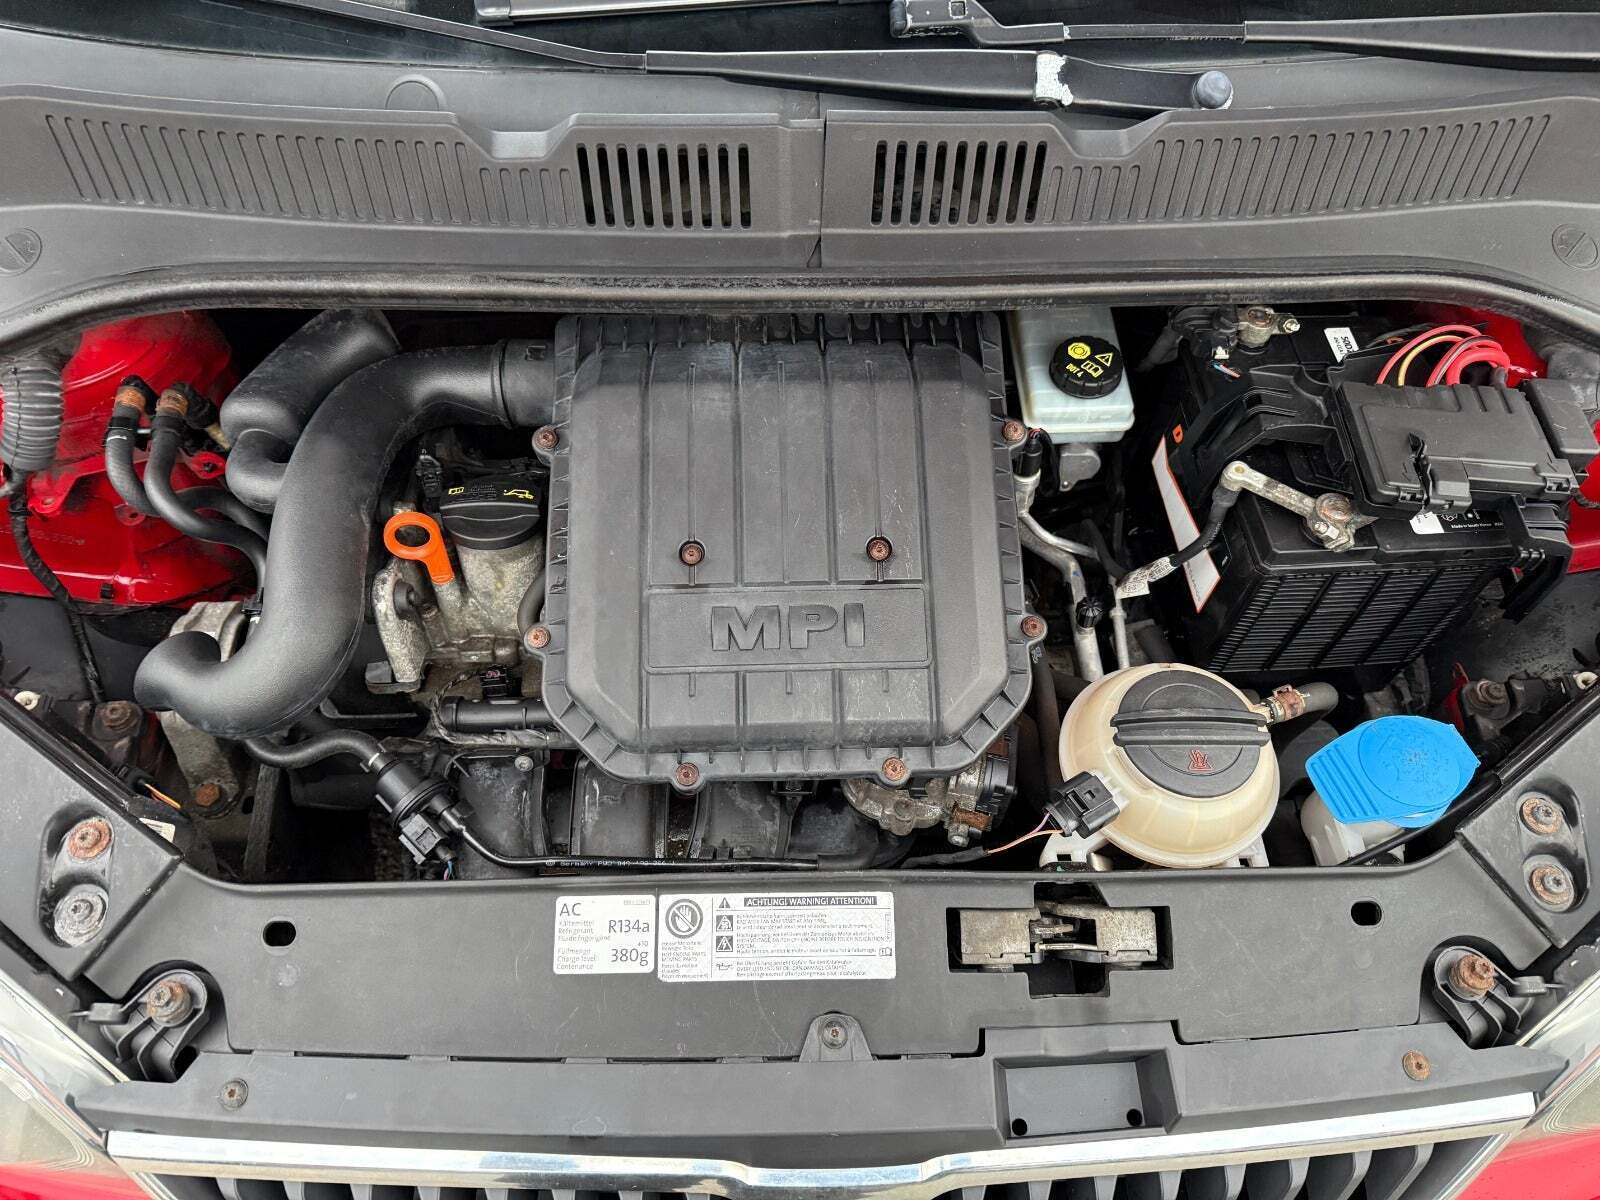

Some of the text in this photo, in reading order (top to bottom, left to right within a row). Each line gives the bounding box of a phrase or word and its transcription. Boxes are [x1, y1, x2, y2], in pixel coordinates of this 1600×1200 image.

[1066, 363, 1079, 374] DOT
[711, 602, 866, 651] MPI
[746, 896, 875, 906] ACHTUNG! WARNING! ATTENTION!
[559, 902, 582, 917] AC
[608, 919, 650, 934] R134a
[611, 948, 649, 967] 380g
